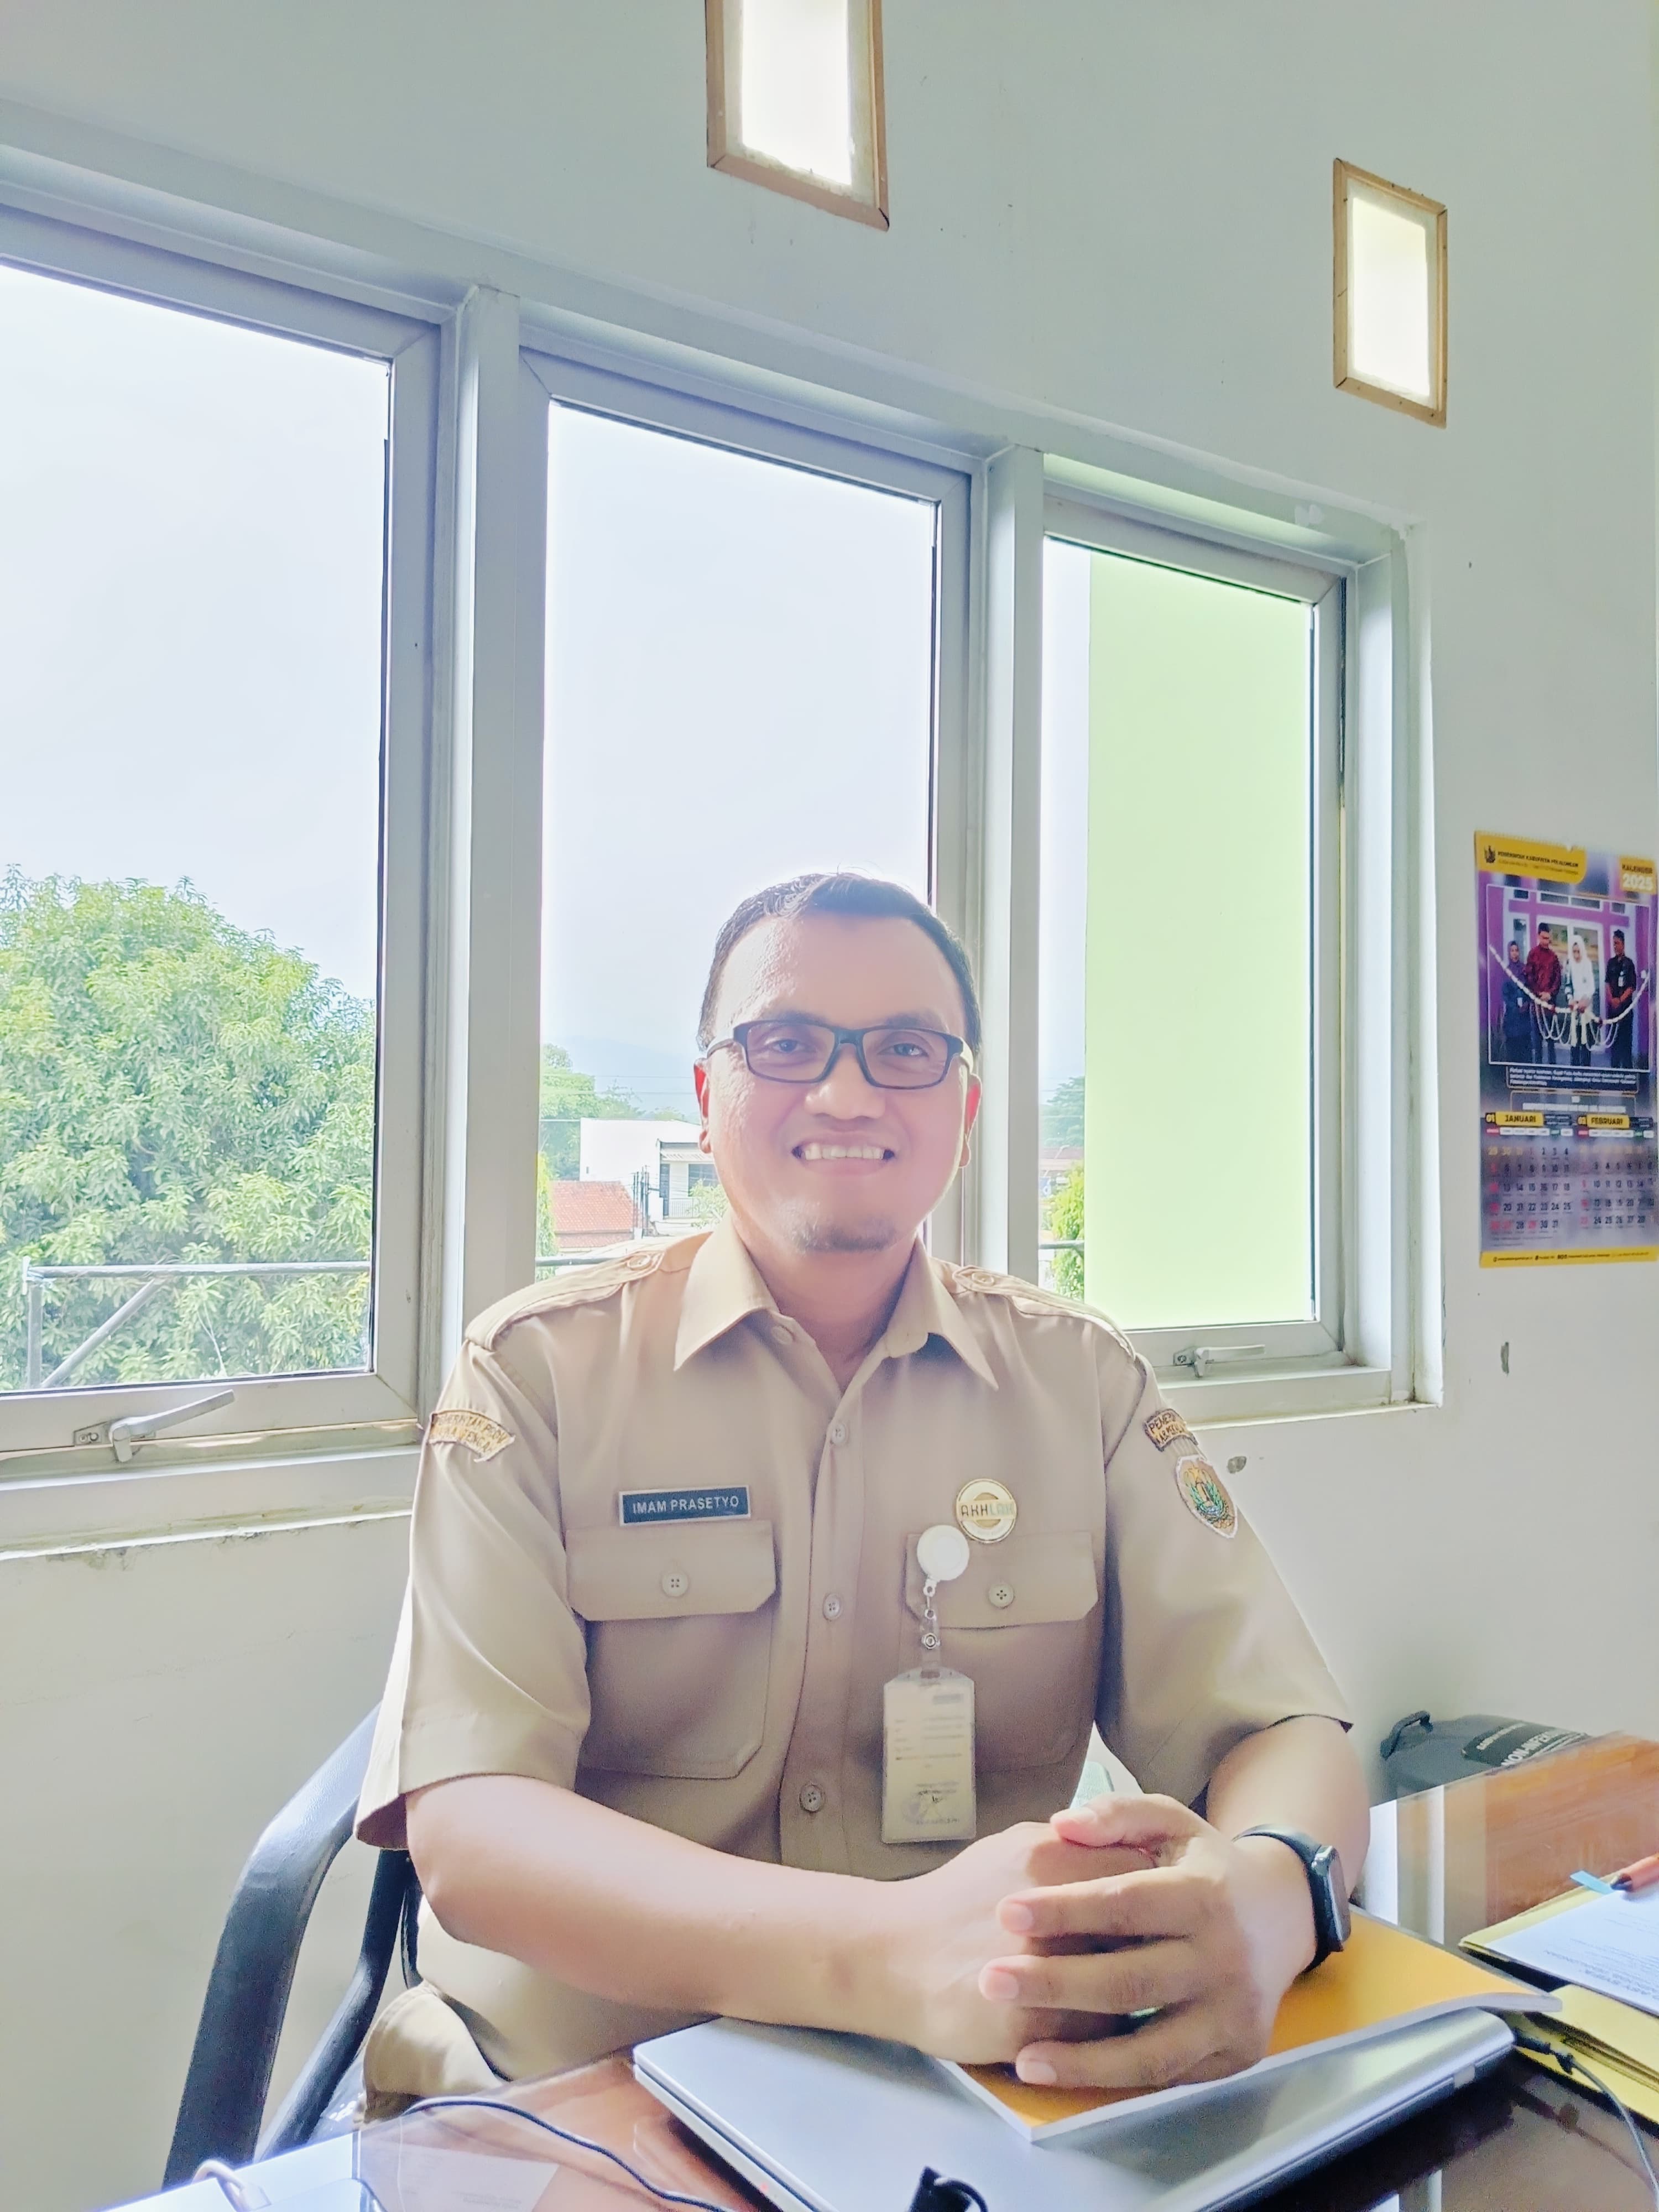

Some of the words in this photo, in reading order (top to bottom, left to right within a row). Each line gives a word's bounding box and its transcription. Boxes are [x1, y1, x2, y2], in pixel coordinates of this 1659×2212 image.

[1623, 873, 1653, 891] 2025
[1504, 1114, 1536, 1123] JANUARI
[1591, 1117, 1623, 1126] FEBRUARI
[633, 1500, 667, 1514] IMAM
[670, 1495, 739, 1511] PRASETYO
